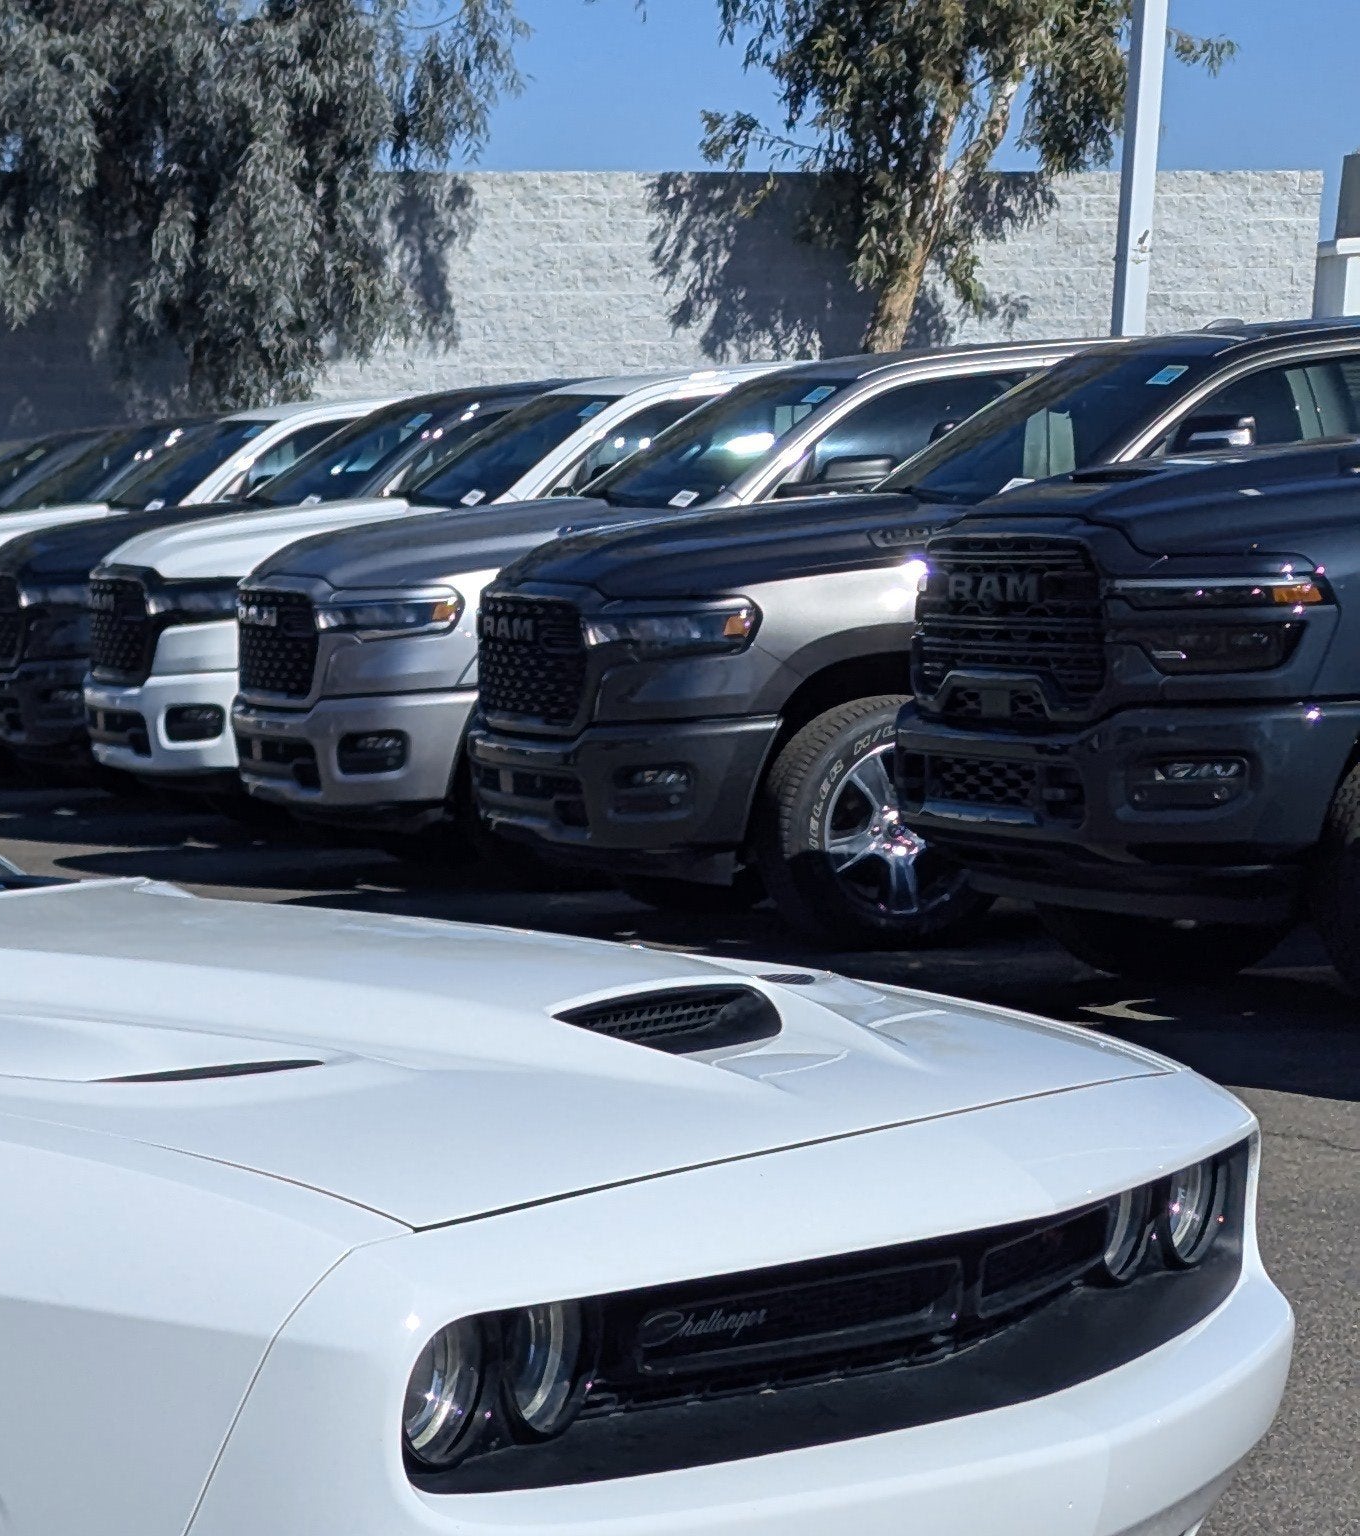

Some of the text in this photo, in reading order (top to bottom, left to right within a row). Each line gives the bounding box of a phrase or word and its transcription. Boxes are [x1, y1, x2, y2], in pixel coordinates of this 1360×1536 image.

[947, 571, 1039, 602] RAM
[483, 616, 534, 641] RAM
[640, 1308, 769, 1348] Challenger
